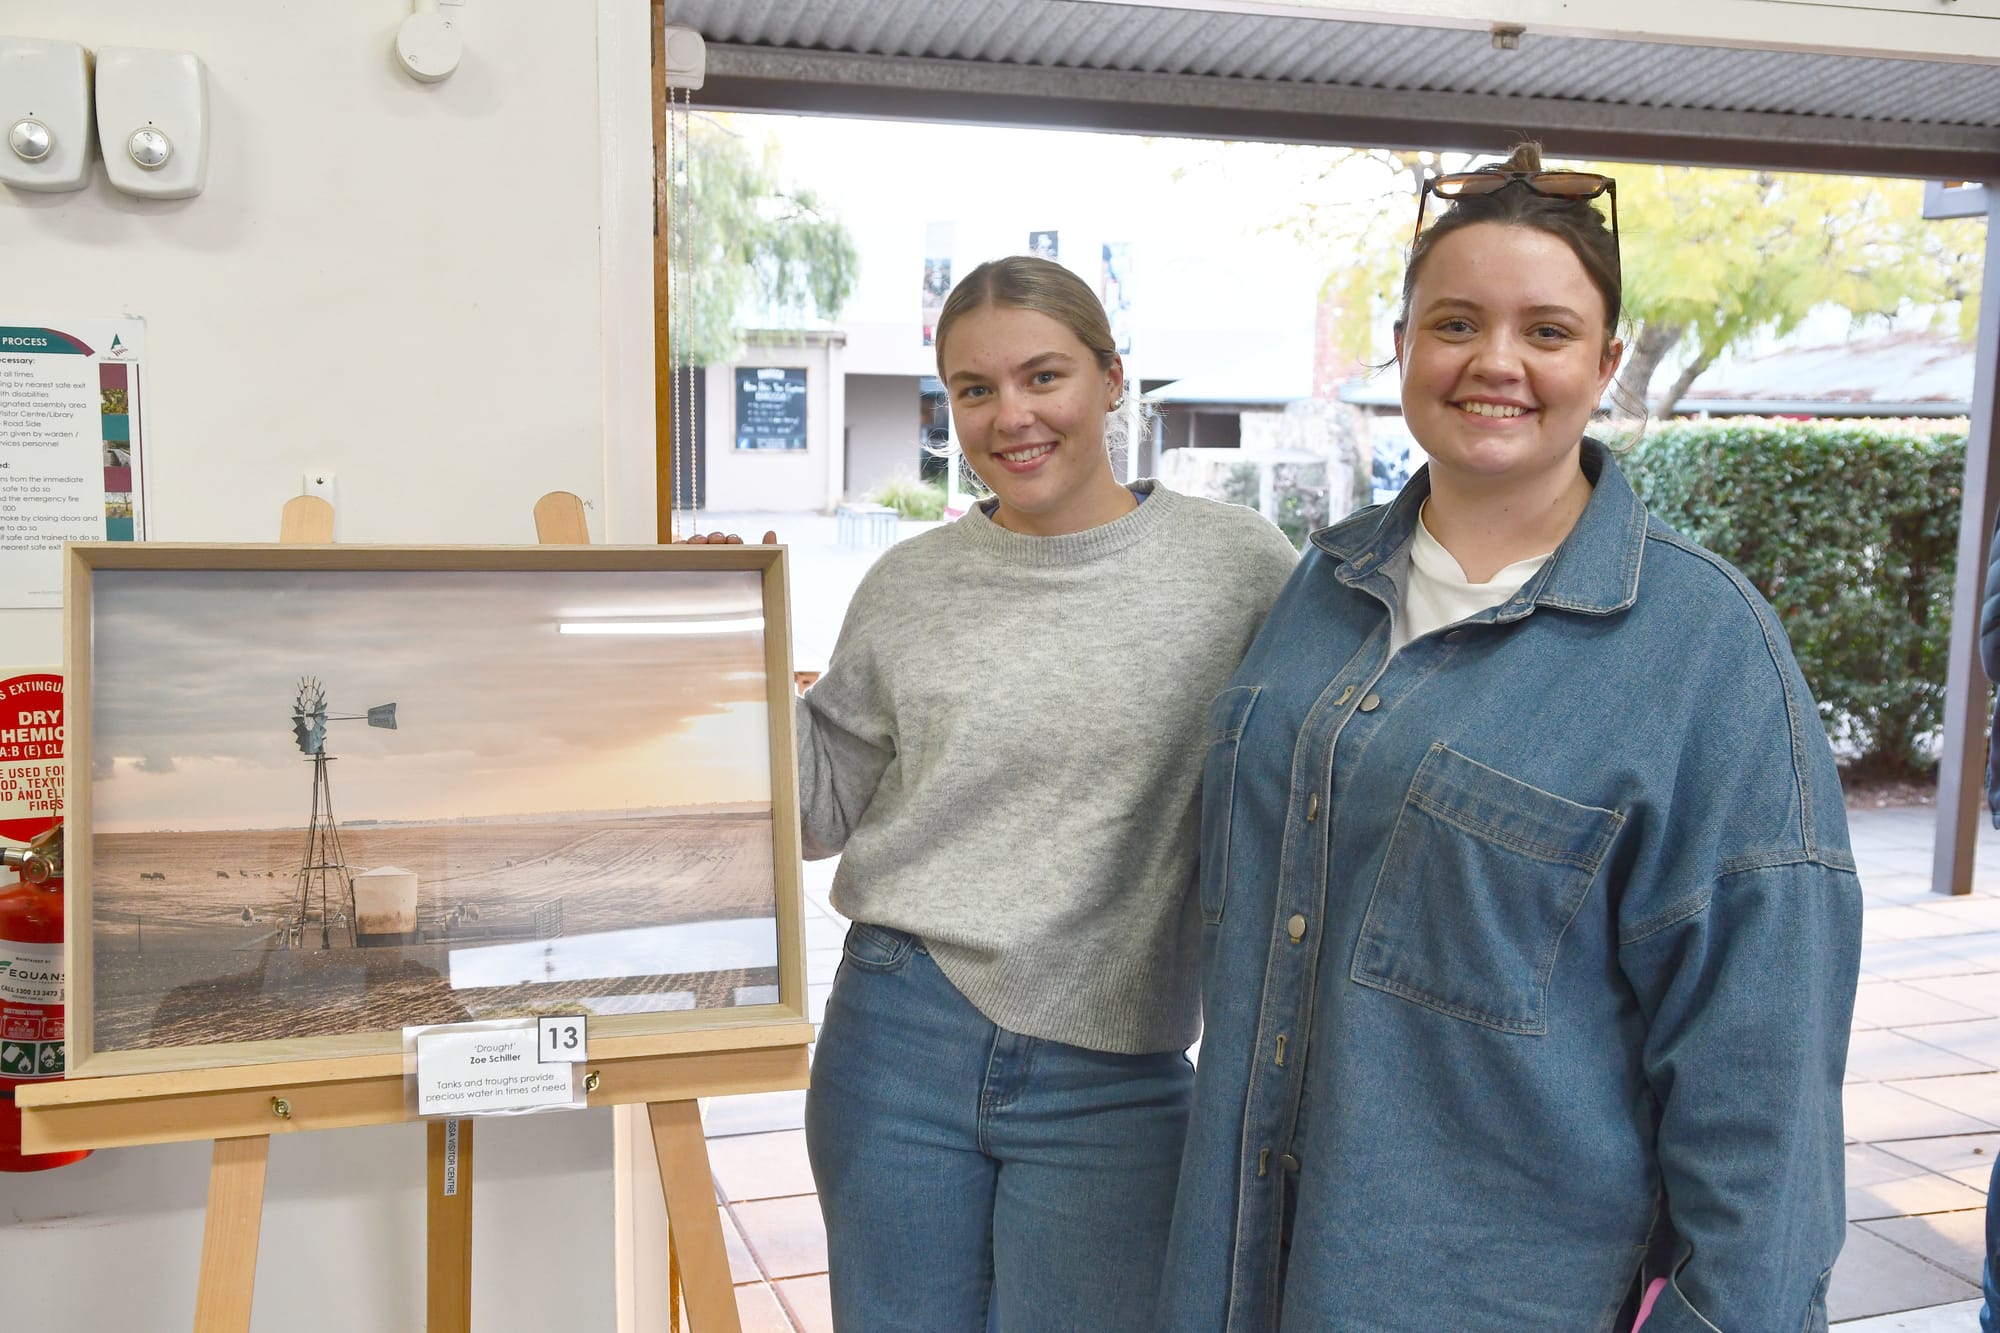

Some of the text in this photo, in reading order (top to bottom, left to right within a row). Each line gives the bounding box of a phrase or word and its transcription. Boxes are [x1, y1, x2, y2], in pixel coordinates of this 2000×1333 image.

[2, 337, 48, 346] PROCESS
[20, 411, 74, 419] Centre/Library
[9, 681, 63, 696] EXTINGU
[18, 710, 60, 726] DRY
[23, 745, 41, 758] (E)
[8, 767, 40, 779] USED
[18, 789, 42, 800] AND
[29, 799, 64, 811] FIRES
[549, 1026, 579, 1049] 13
[470, 1053, 521, 1064] Zoe Schiller
[437, 1073, 554, 1089] Tanks and troughs provide
[426, 1083, 566, 1102] precious water in times of need
[448, 1140, 456, 1165] VISITOR
[447, 1166, 455, 1194] CENTRE
